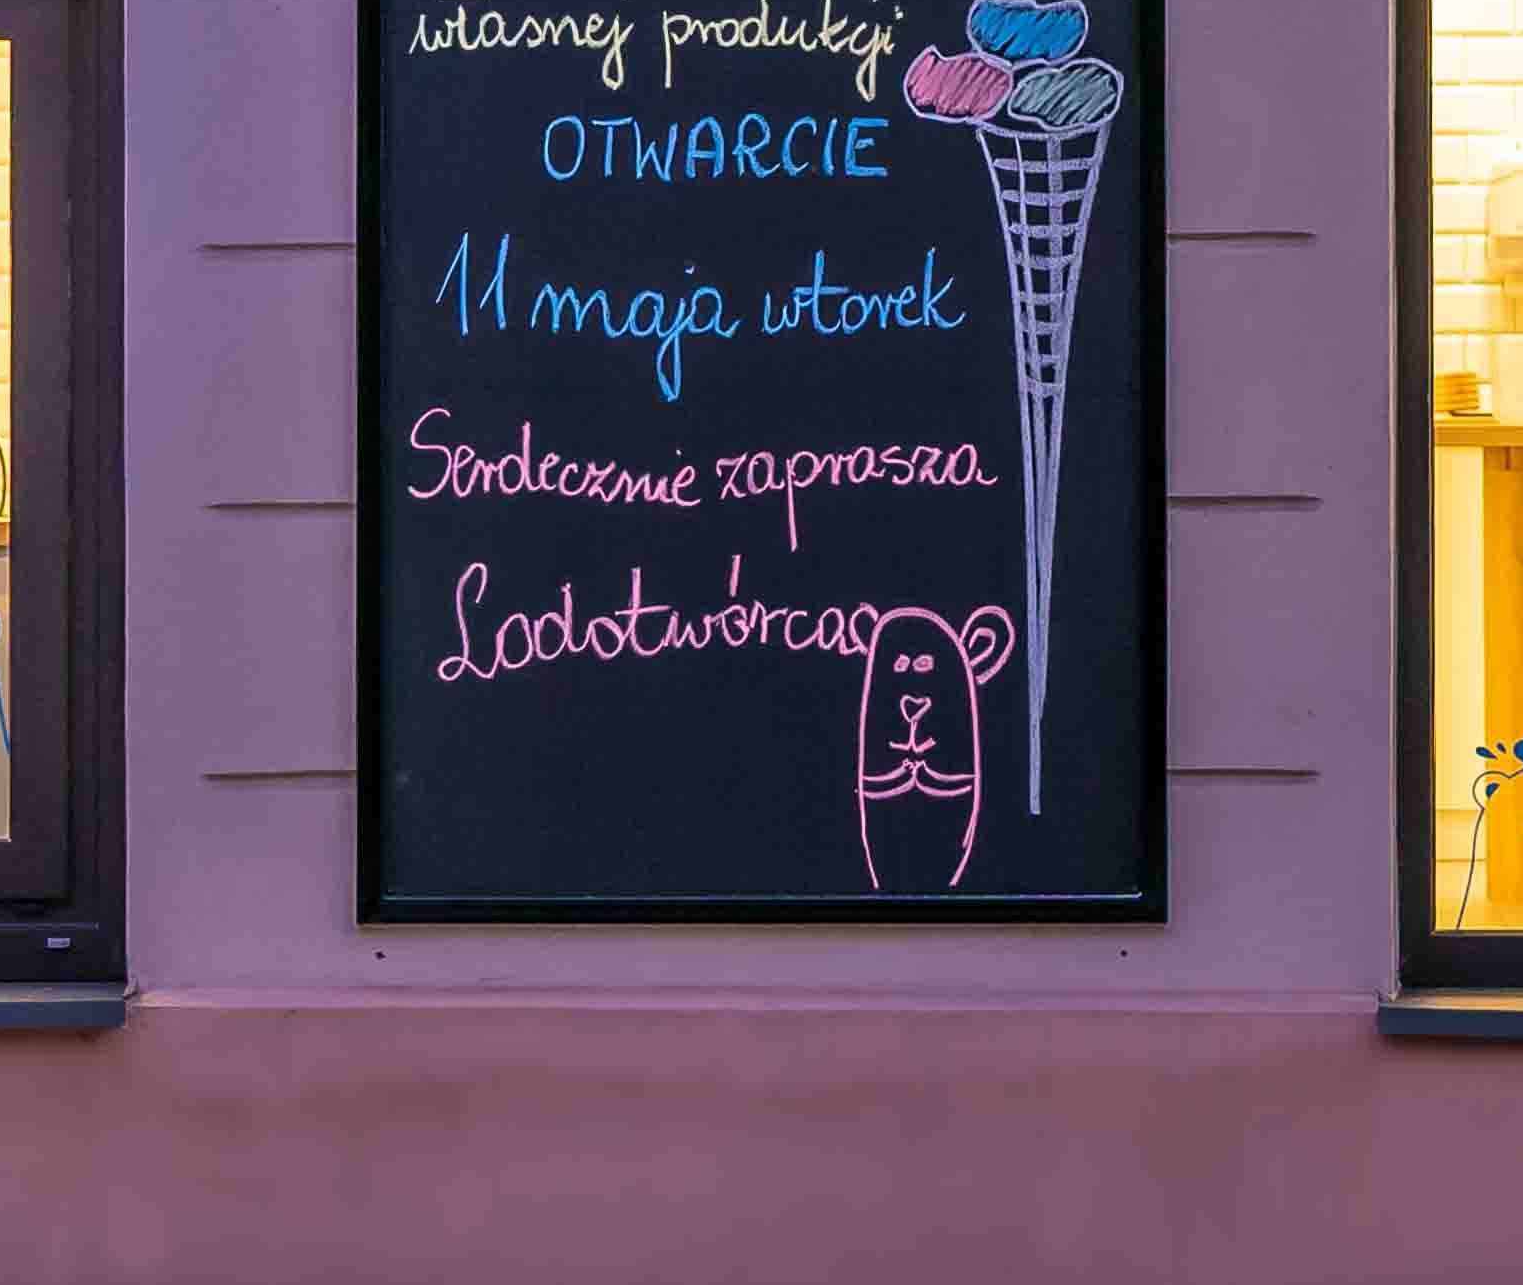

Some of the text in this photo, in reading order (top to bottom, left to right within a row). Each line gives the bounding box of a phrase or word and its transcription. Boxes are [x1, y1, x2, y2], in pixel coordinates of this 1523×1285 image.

[543, 115, 890, 181] OTWARCIE
[436, 232, 967, 401] 11 maja wtorek
[407, 408, 702, 507] Serdecznie
[438, 554, 864, 681] Lodotwórca
